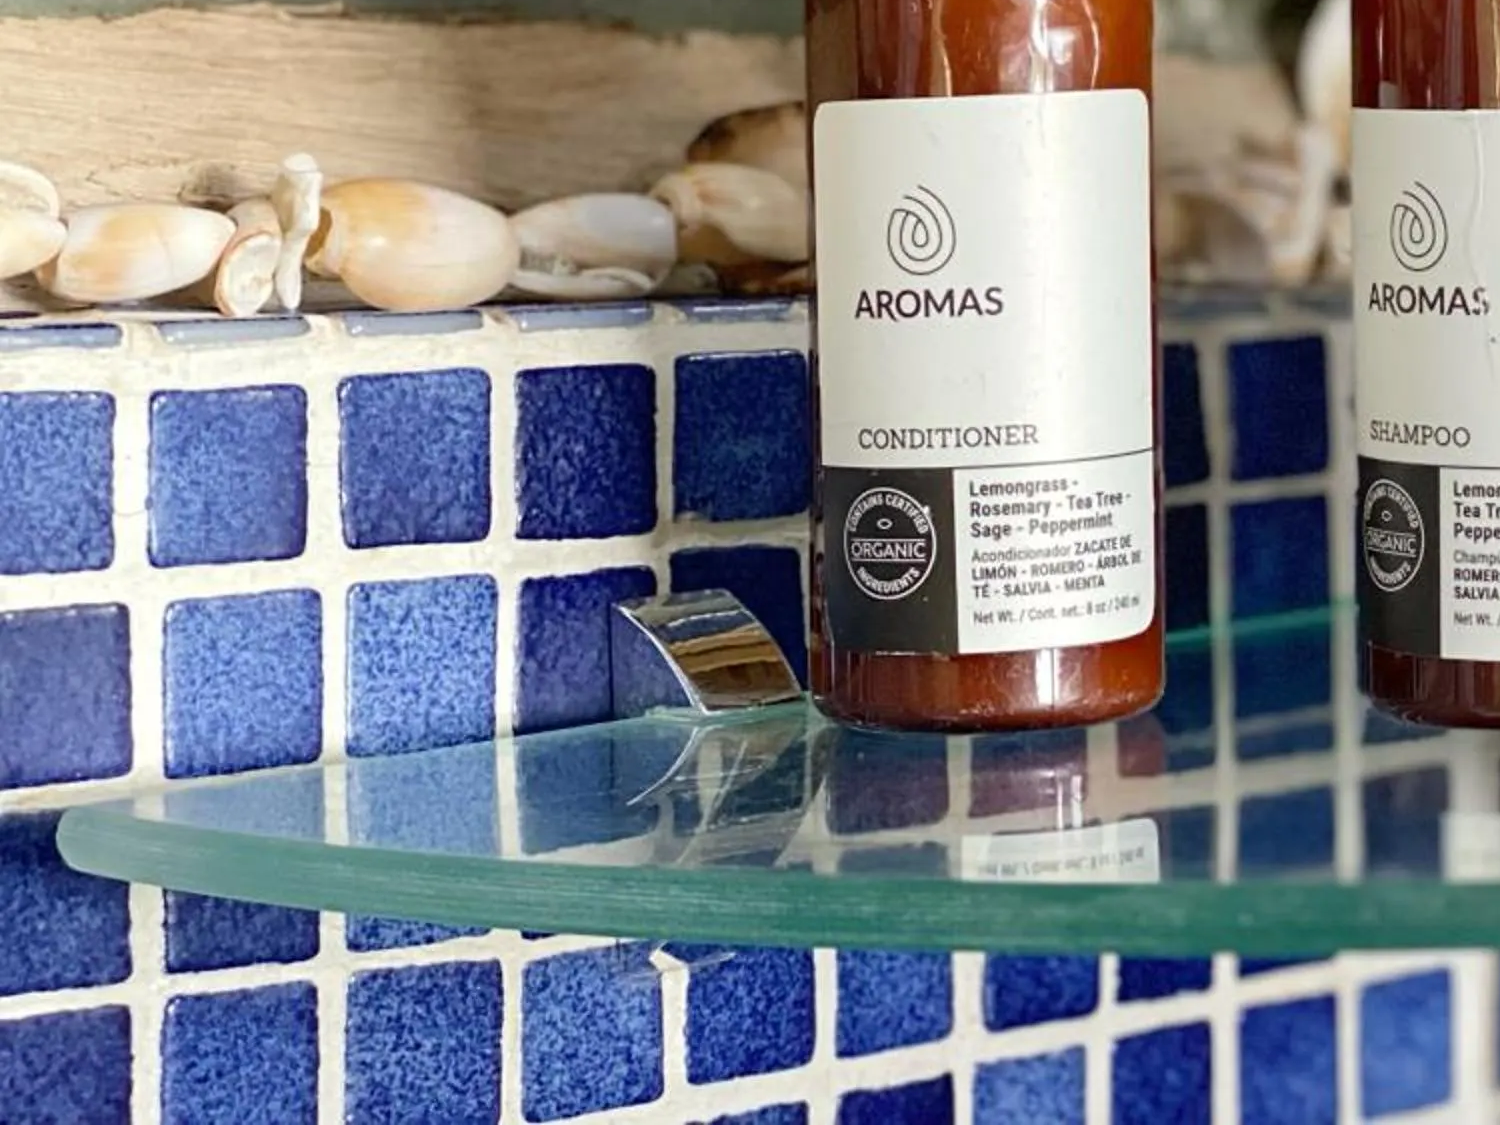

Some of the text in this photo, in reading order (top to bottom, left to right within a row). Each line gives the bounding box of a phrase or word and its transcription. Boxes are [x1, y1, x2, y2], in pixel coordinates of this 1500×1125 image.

[855, 286, 1004, 322] AROMAS
[1368, 282, 1491, 317] AROMAS
[858, 424, 1039, 450] CONDITIONER
[1370, 419, 1471, 448] SHAMPOO
[969, 478, 1068, 497] Lemongrass
[970, 500, 1051, 517] Rosemary
[1066, 495, 1092, 510] Tea
[1095, 491, 1123, 507] Tree
[1454, 502, 1481, 518] Tea
[970, 522, 1012, 541] Sage
[1029, 512, 1113, 537] Peppermint
[851, 541, 926, 558] ORGANIC
[971, 534, 1132, 563] Acondicionador ZACATE DE
[971, 565, 1017, 581] LIMÓN
[1030, 559, 1085, 576] ROMERO
[1002, 581, 1051, 597] SALVIA
[1064, 575, 1105, 592] MENTA
[1454, 586, 1499, 600] SALVIA
[973, 611, 993, 624] Net
[1453, 611, 1472, 625] Net
